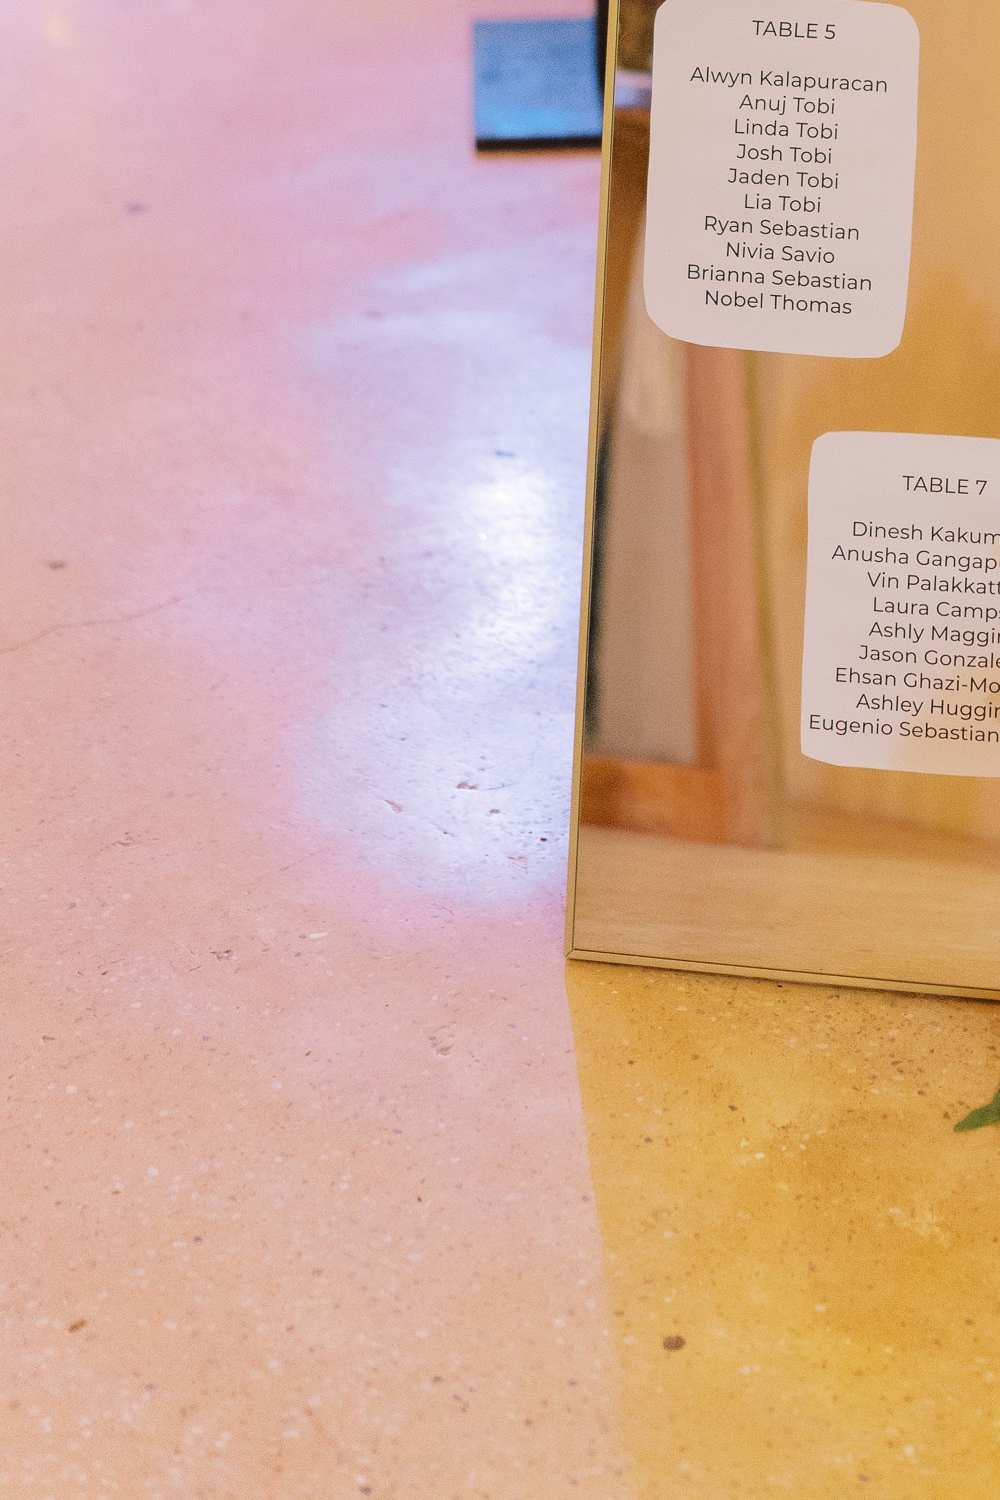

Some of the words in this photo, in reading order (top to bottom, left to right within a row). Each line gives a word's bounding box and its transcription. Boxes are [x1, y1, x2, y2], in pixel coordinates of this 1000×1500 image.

[751, 19, 819, 40] TABLE
[823, 23, 837, 41] 5
[688, 65, 753, 89] Alwyn
[759, 69, 888, 94] Kalapuracan
[738, 93, 787, 117] Anuj
[792, 96, 836, 116] Tobi
[734, 117, 790, 138] Linda
[795, 121, 839, 141] Tobi
[735, 142, 783, 162] Josh
[788, 145, 833, 165] Tobi
[726, 167, 790, 187] Jaden
[795, 170, 840, 190] Tobi
[743, 192, 772, 211] Lia
[777, 194, 822, 214] Tobi
[704, 214, 754, 237] Ryan
[759, 218, 860, 241] Sebastian
[725, 240, 775, 261] Nivia
[780, 244, 836, 265] Savio
[686, 263, 766, 285] Brianna
[771, 269, 872, 292] Sebastian
[704, 289, 764, 310] Nobel
[769, 293, 853, 315] Thomas
[901, 474, 970, 496] TABLE
[975, 479, 988, 496] 7
[852, 520, 924, 541] Dinesh
[830, 544, 910, 566] Anusha
[866, 570, 900, 590] Vin
[872, 596, 930, 617] Laura
[867, 620, 926, 645] Ashly
[858, 643, 918, 665] Jason
[835, 666, 897, 688] Ehsan
[854, 692, 925, 718] Ashley
[808, 713, 894, 737] Eugenio
[898, 720, 1000, 744] Sebastian
